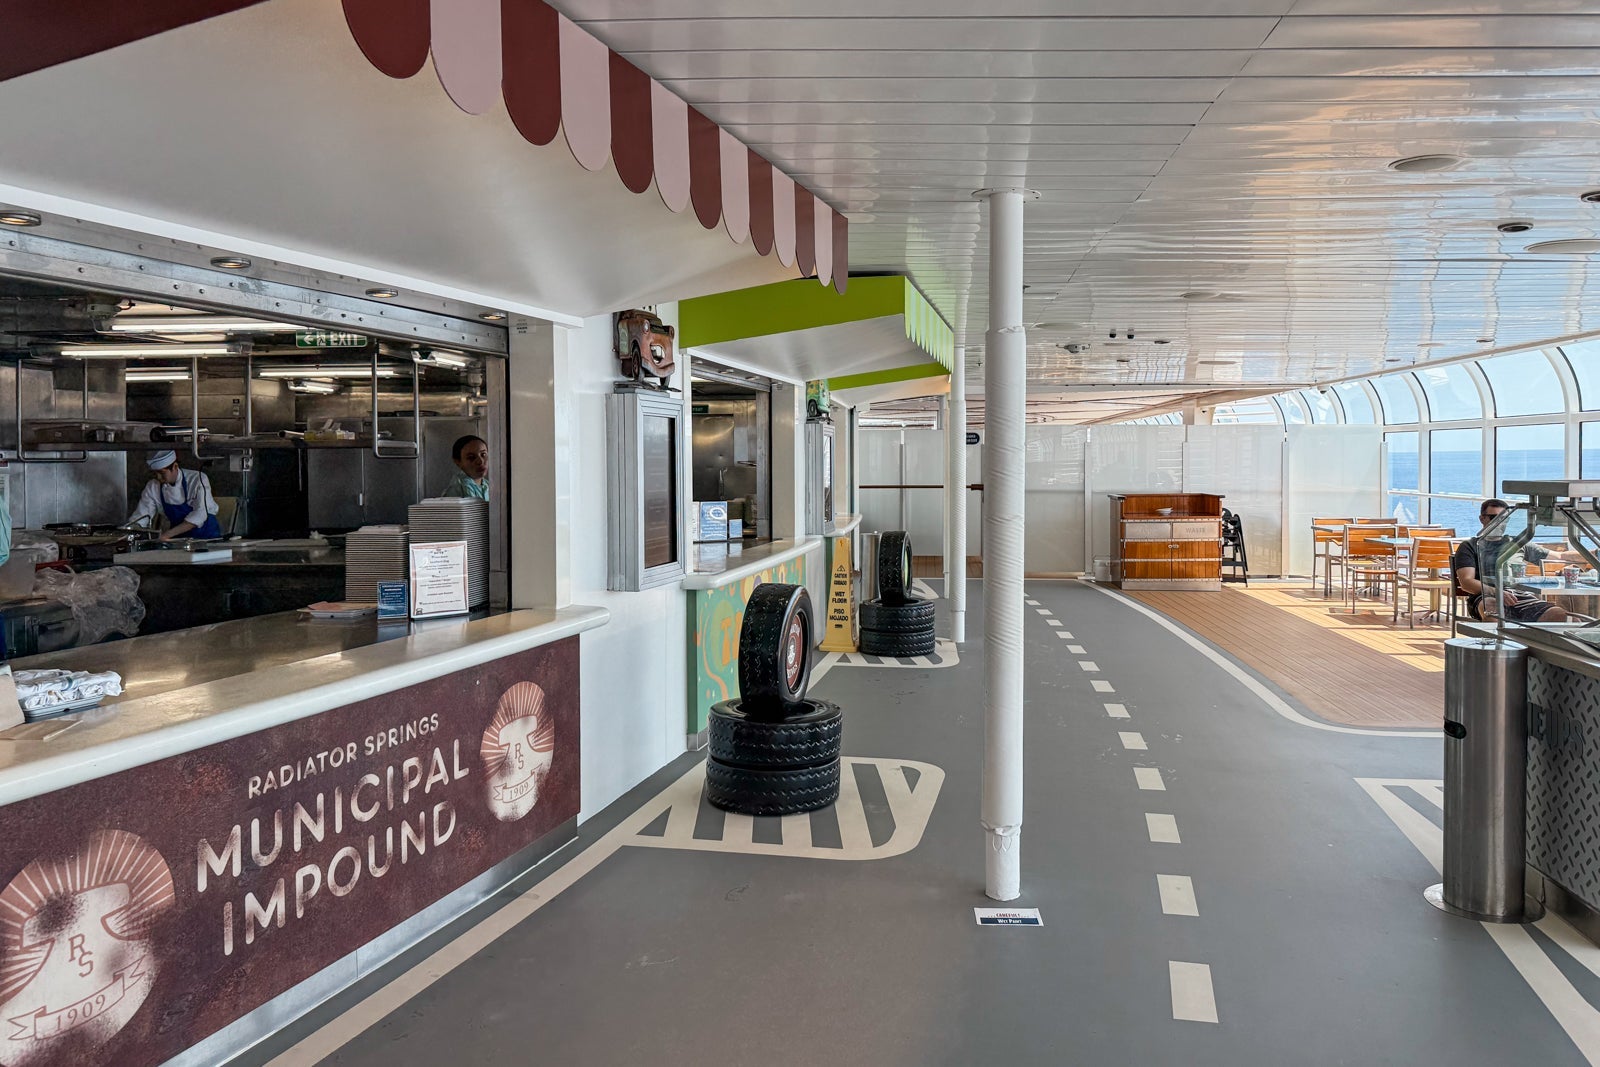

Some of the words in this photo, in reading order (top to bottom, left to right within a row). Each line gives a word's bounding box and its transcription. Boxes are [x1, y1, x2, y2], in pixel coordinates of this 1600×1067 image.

[829, 614, 849, 622] MOJADO
[248, 741, 358, 800] RADIATOR
[364, 712, 440, 756] SPRINGS
[197, 738, 470, 893] MUNICIPAL
[509, 781, 530, 800] 1909
[223, 800, 457, 956] IMPOUND
[54, 993, 107, 1032] 1909
